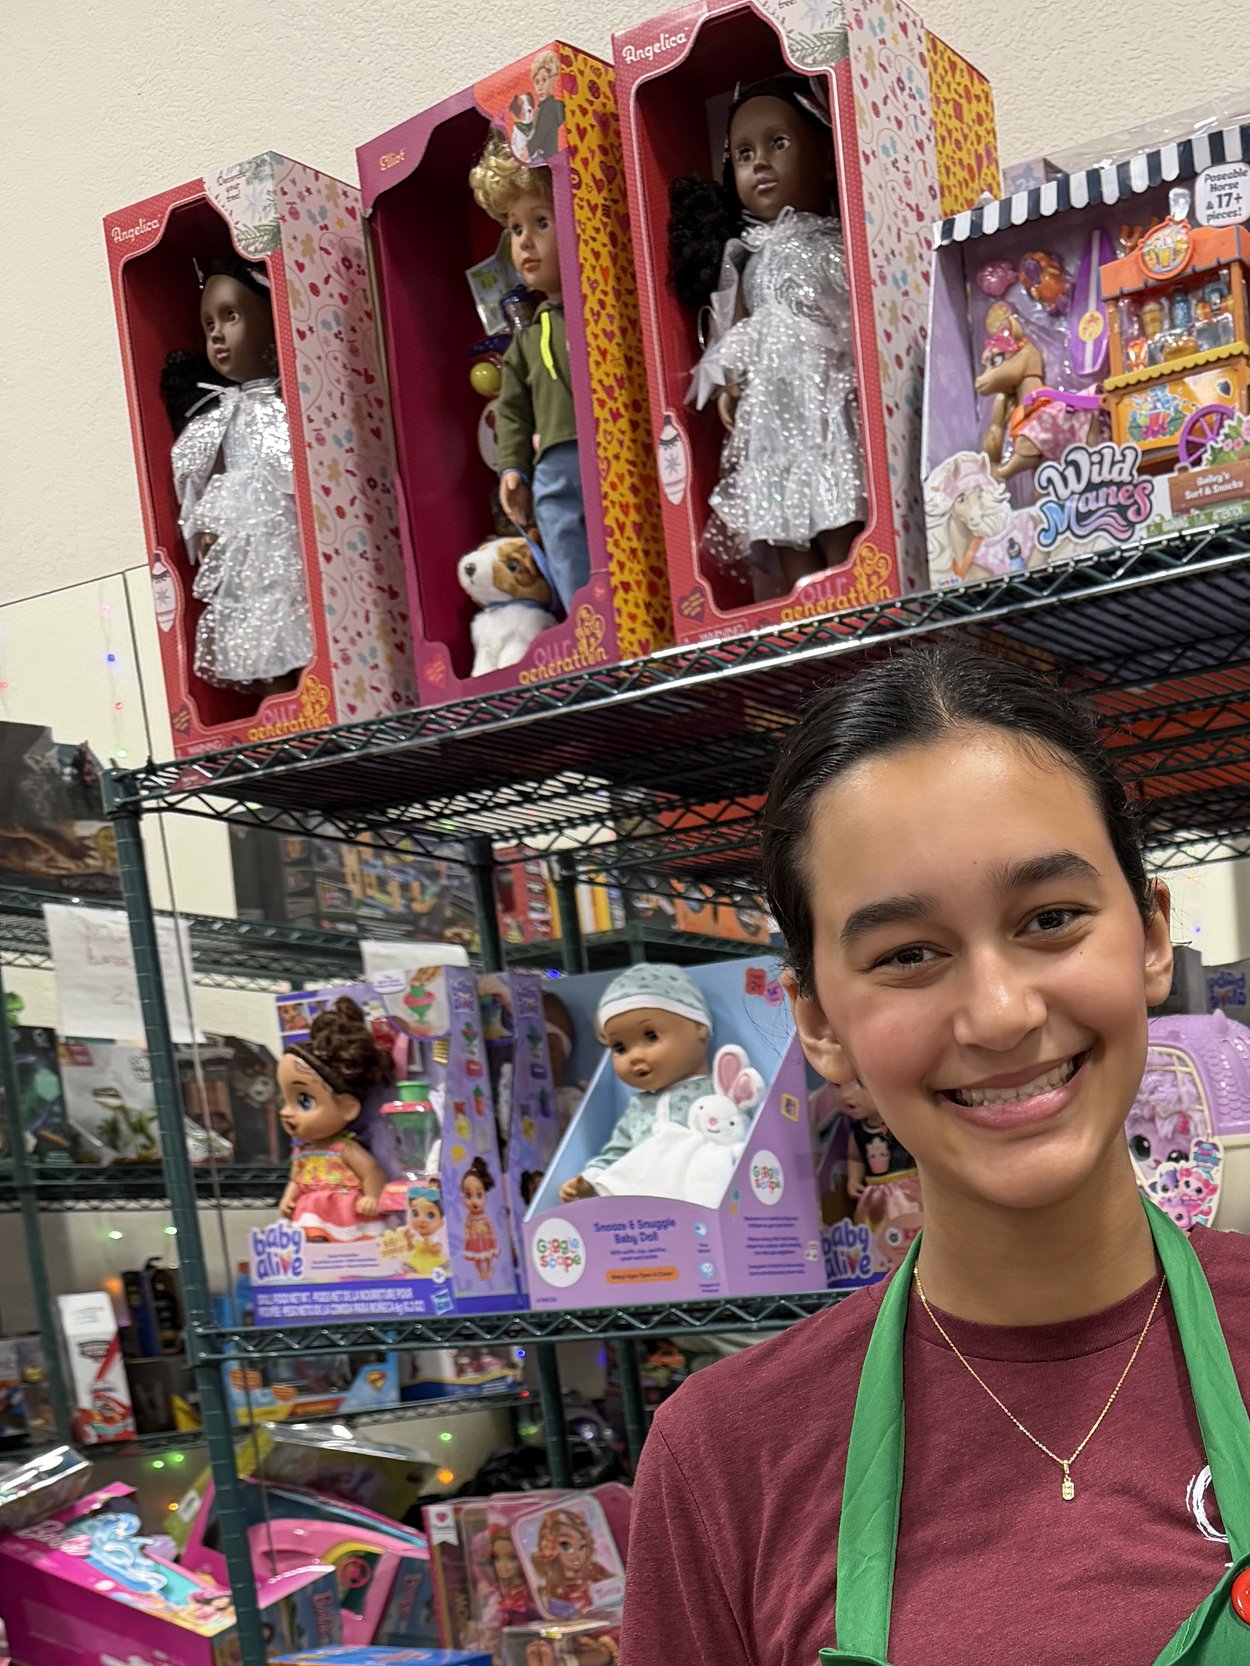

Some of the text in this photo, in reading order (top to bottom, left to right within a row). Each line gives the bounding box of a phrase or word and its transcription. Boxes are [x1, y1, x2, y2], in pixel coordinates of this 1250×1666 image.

[622, 31, 688, 64] Angelica
[1204, 167, 1249, 183] Poseable
[1209, 180, 1240, 193] Horse
[1216, 191, 1243, 209] 17+
[1206, 206, 1242, 223] pieces!
[111, 218, 160, 243] Angelica
[1037, 445, 1138, 498] Wild
[1038, 481, 1153, 548] Manes
[780, 584, 893, 622] generation
[518, 647, 608, 686] generation
[247, 713, 332, 741] generation
[253, 1221, 303, 1257] baby
[537, 1236, 580, 1256] Giggle
[615, 1231, 659, 1246] Baby Doll
[256, 1248, 303, 1280] alive
